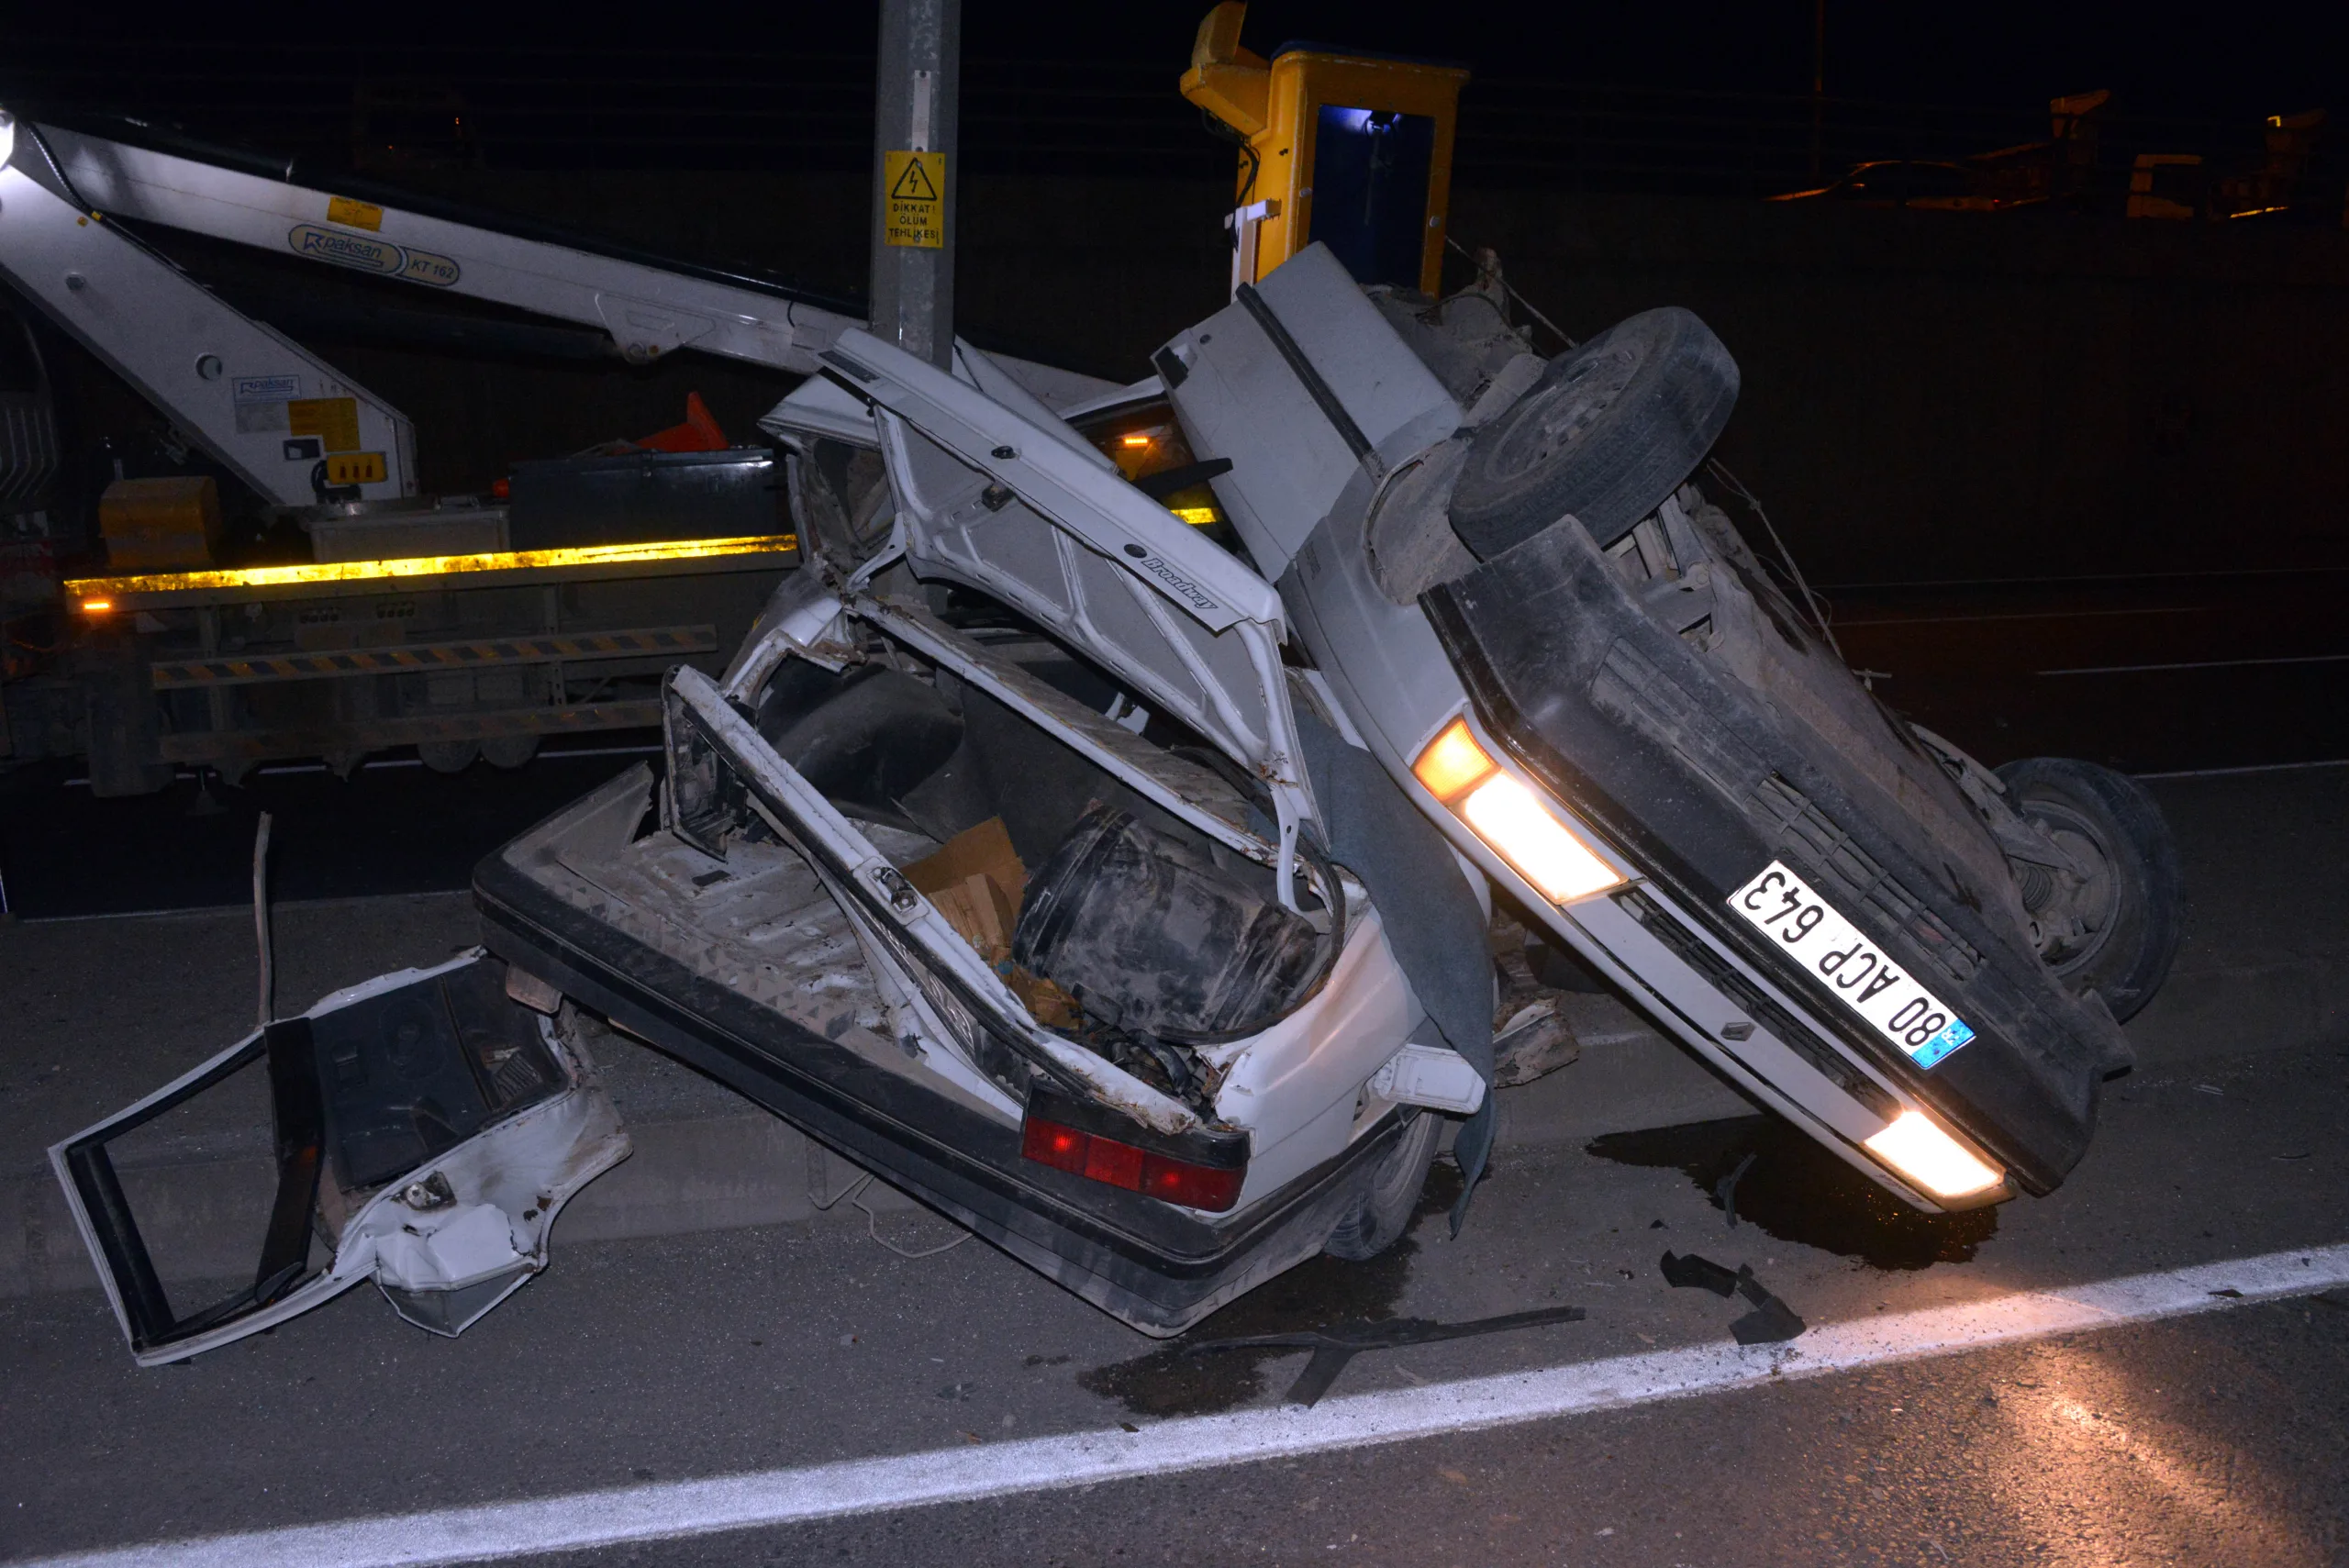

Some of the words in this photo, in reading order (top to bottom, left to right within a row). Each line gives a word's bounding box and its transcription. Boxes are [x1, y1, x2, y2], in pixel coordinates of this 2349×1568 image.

[888, 228, 941, 239] TEHLİKESİ
[899, 213, 928, 226] ÖLÜM
[411, 259, 431, 272] KT
[433, 264, 455, 279] 162
[1141, 557, 1219, 609] Broadway
[1743, 871, 1824, 943] 643
[1819, 943, 1900, 1004] ACP
[1887, 996, 1946, 1047] 80
